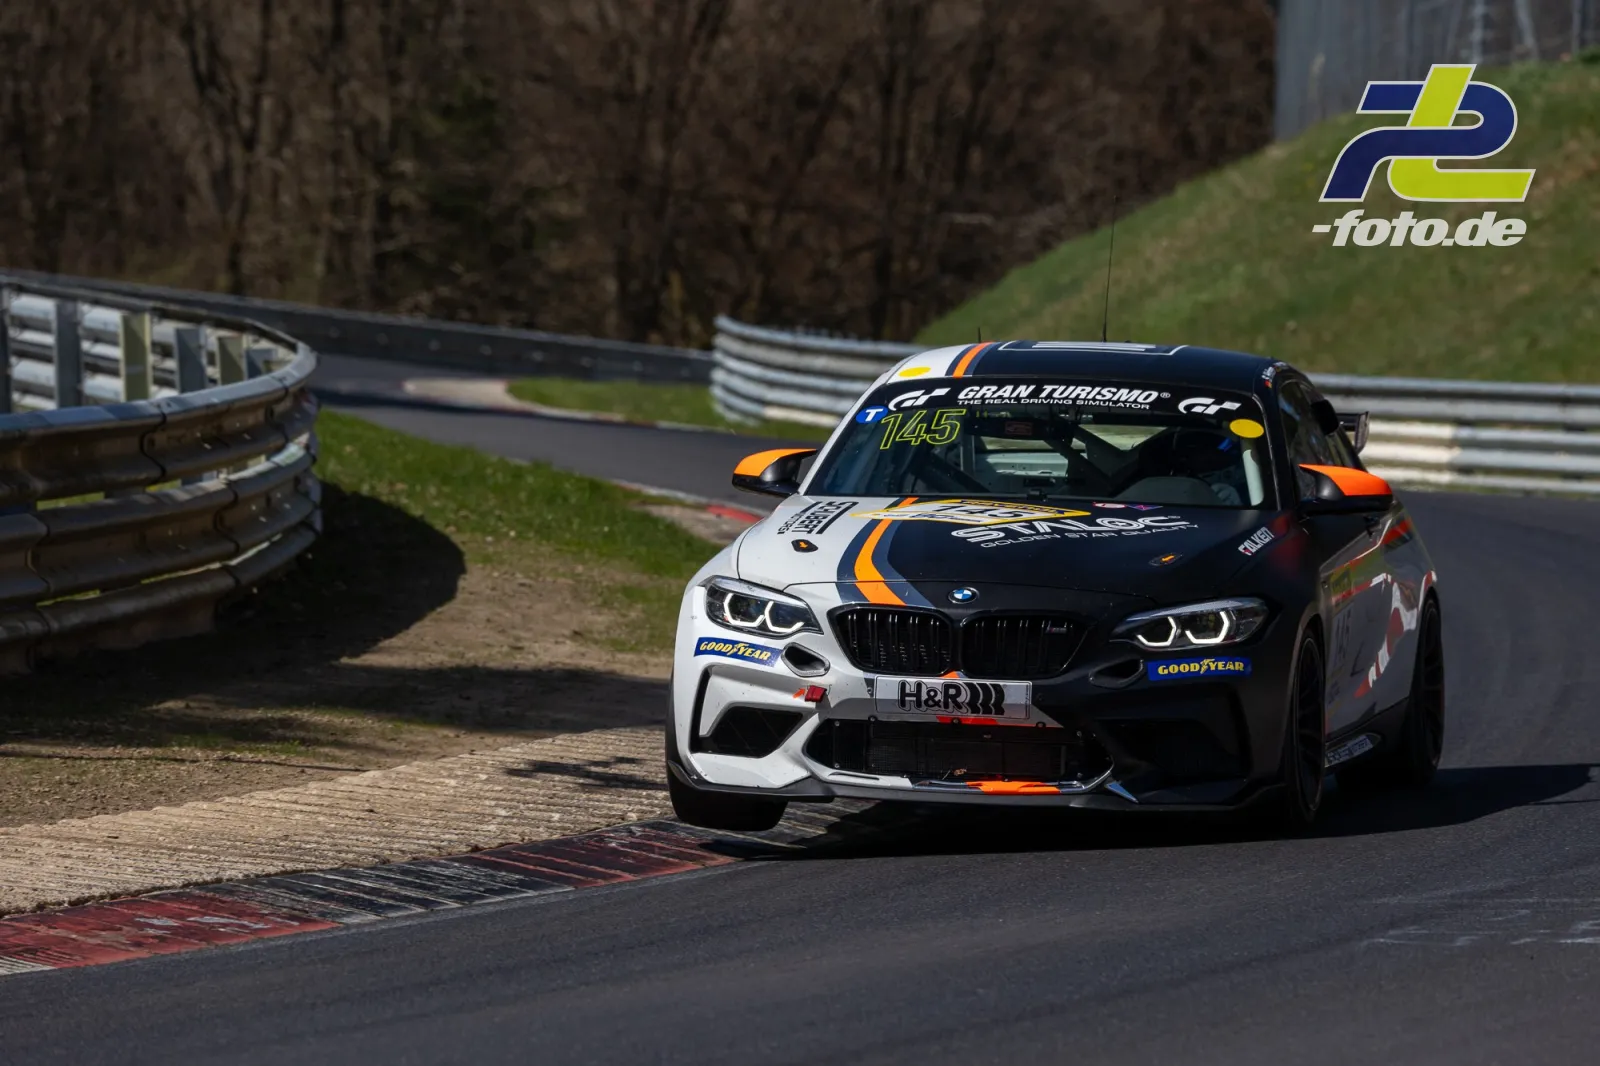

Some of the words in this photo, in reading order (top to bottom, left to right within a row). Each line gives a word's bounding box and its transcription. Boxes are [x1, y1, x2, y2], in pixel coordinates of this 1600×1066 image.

[957, 384, 1036, 399] GRAN
[1076, 399, 1150, 410] SIMULATOR
[880, 408, 967, 450] 145
[931, 505, 1035, 518] 145
[980, 533, 1061, 548] GOLDEN
[1238, 526, 1275, 556] FALKEN
[899, 680, 969, 713] H&R
